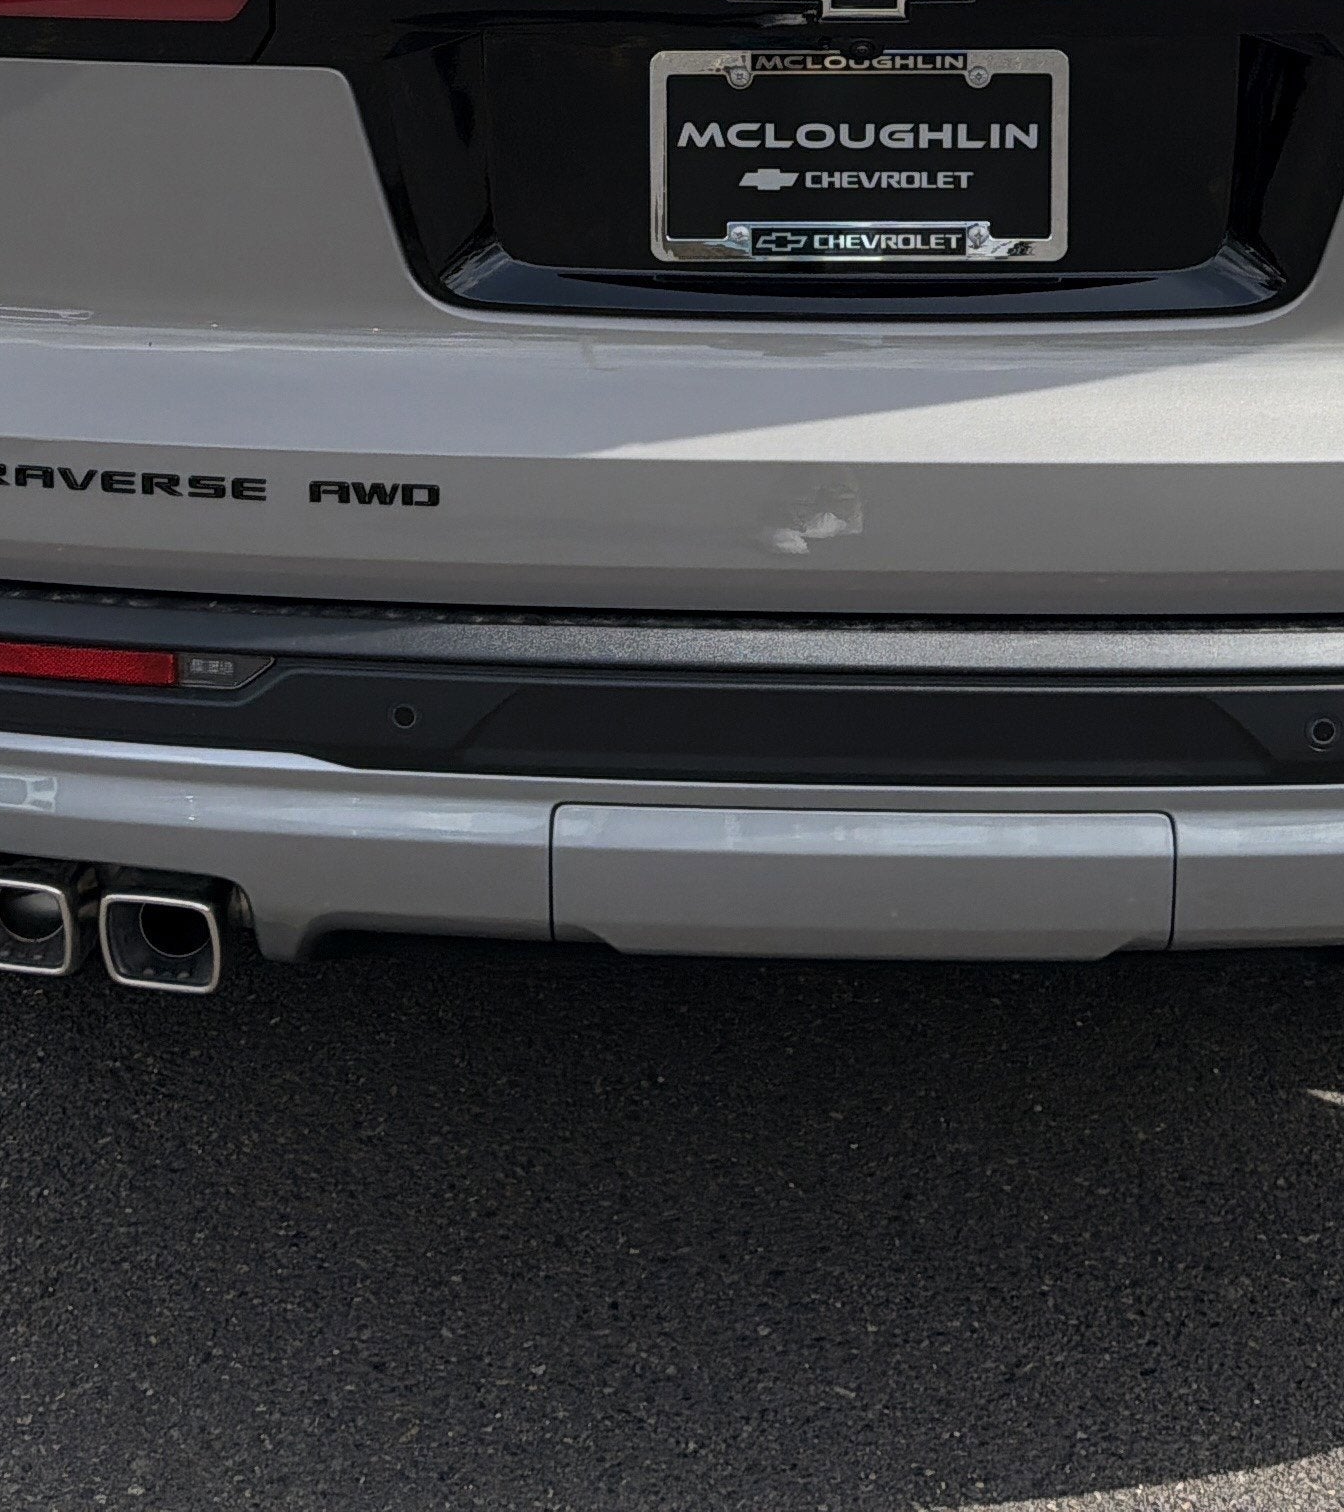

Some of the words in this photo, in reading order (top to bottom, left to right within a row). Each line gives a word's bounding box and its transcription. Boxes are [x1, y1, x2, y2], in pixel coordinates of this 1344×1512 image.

[755, 53, 966, 70] MCLOUGHLIN
[677, 121, 1039, 150] MCLOUGHLIN
[805, 170, 974, 190] CHEVROLET
[812, 233, 963, 251] CHEVROLET
[309, 480, 441, 507] AWD
